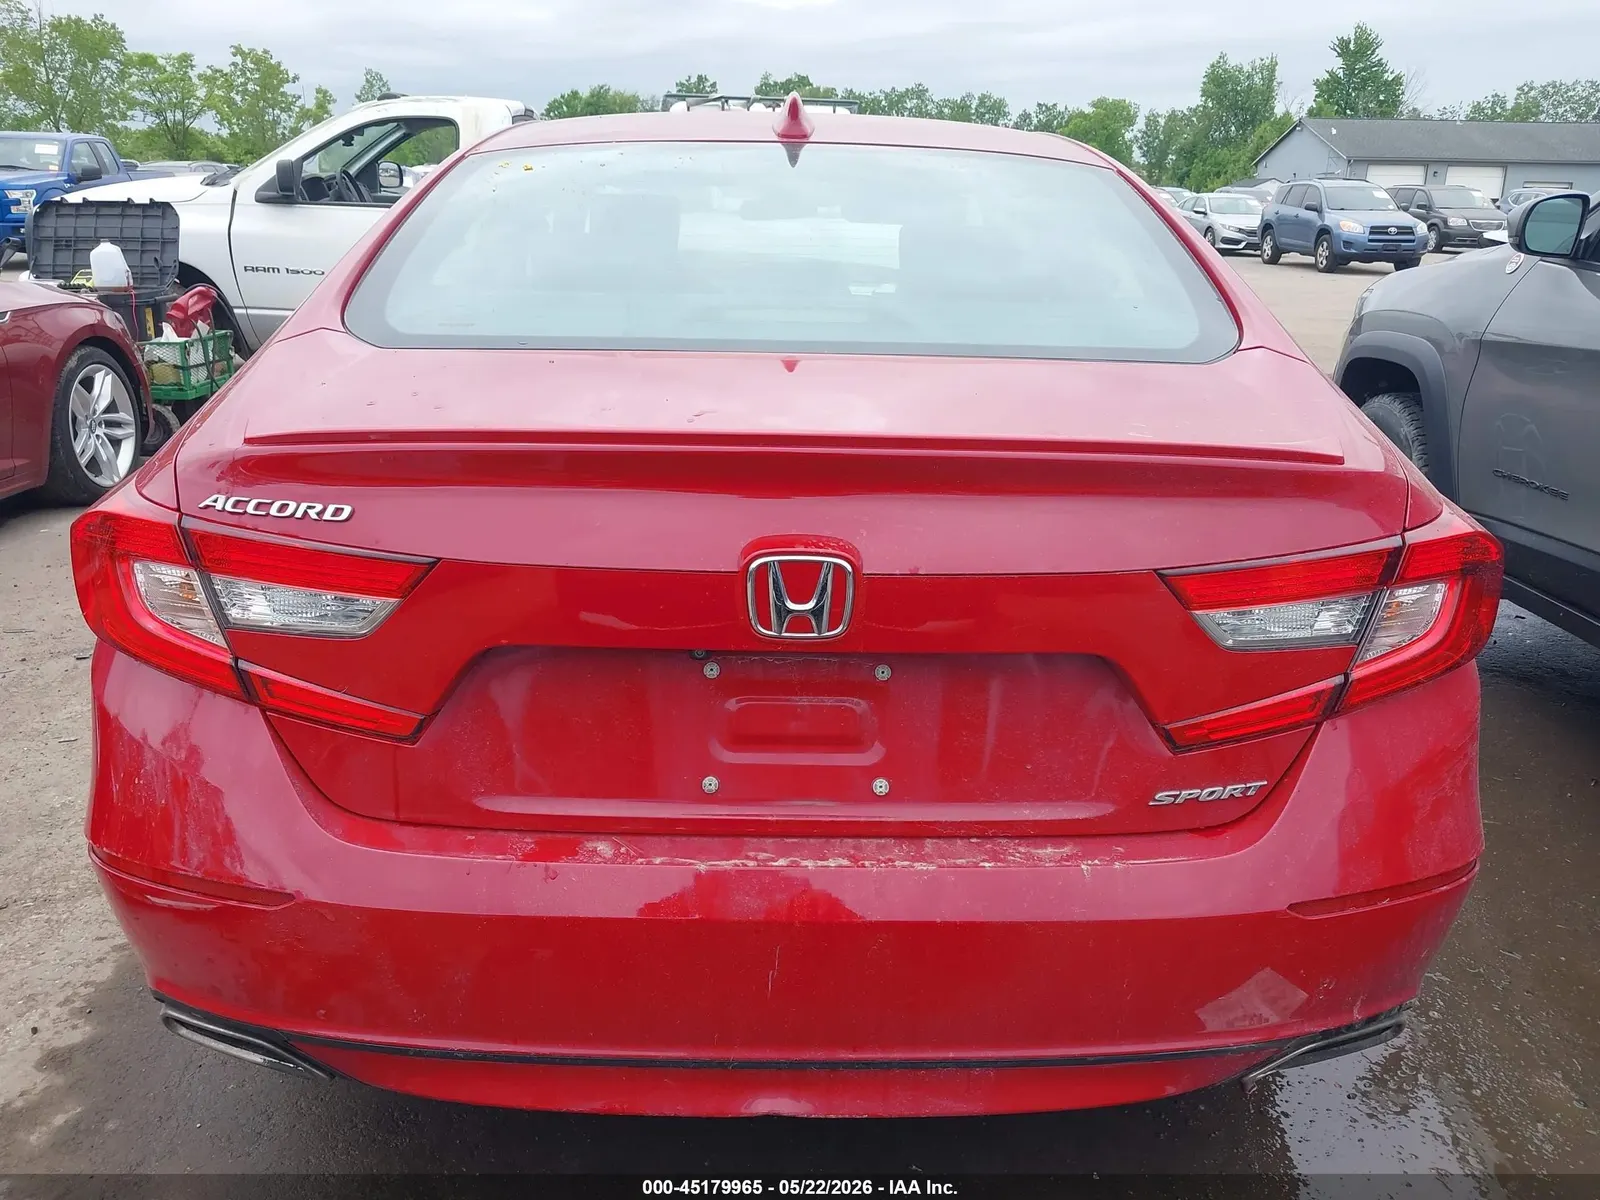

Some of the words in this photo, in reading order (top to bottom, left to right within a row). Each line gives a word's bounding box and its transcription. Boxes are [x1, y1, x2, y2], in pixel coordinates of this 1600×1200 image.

[243, 265, 281, 274] RAM
[285, 267, 325, 276] 1500
[1492, 468, 1569, 501] CHEROKEE
[198, 494, 354, 522] ACCORD
[1148, 780, 1268, 806] SPORT
